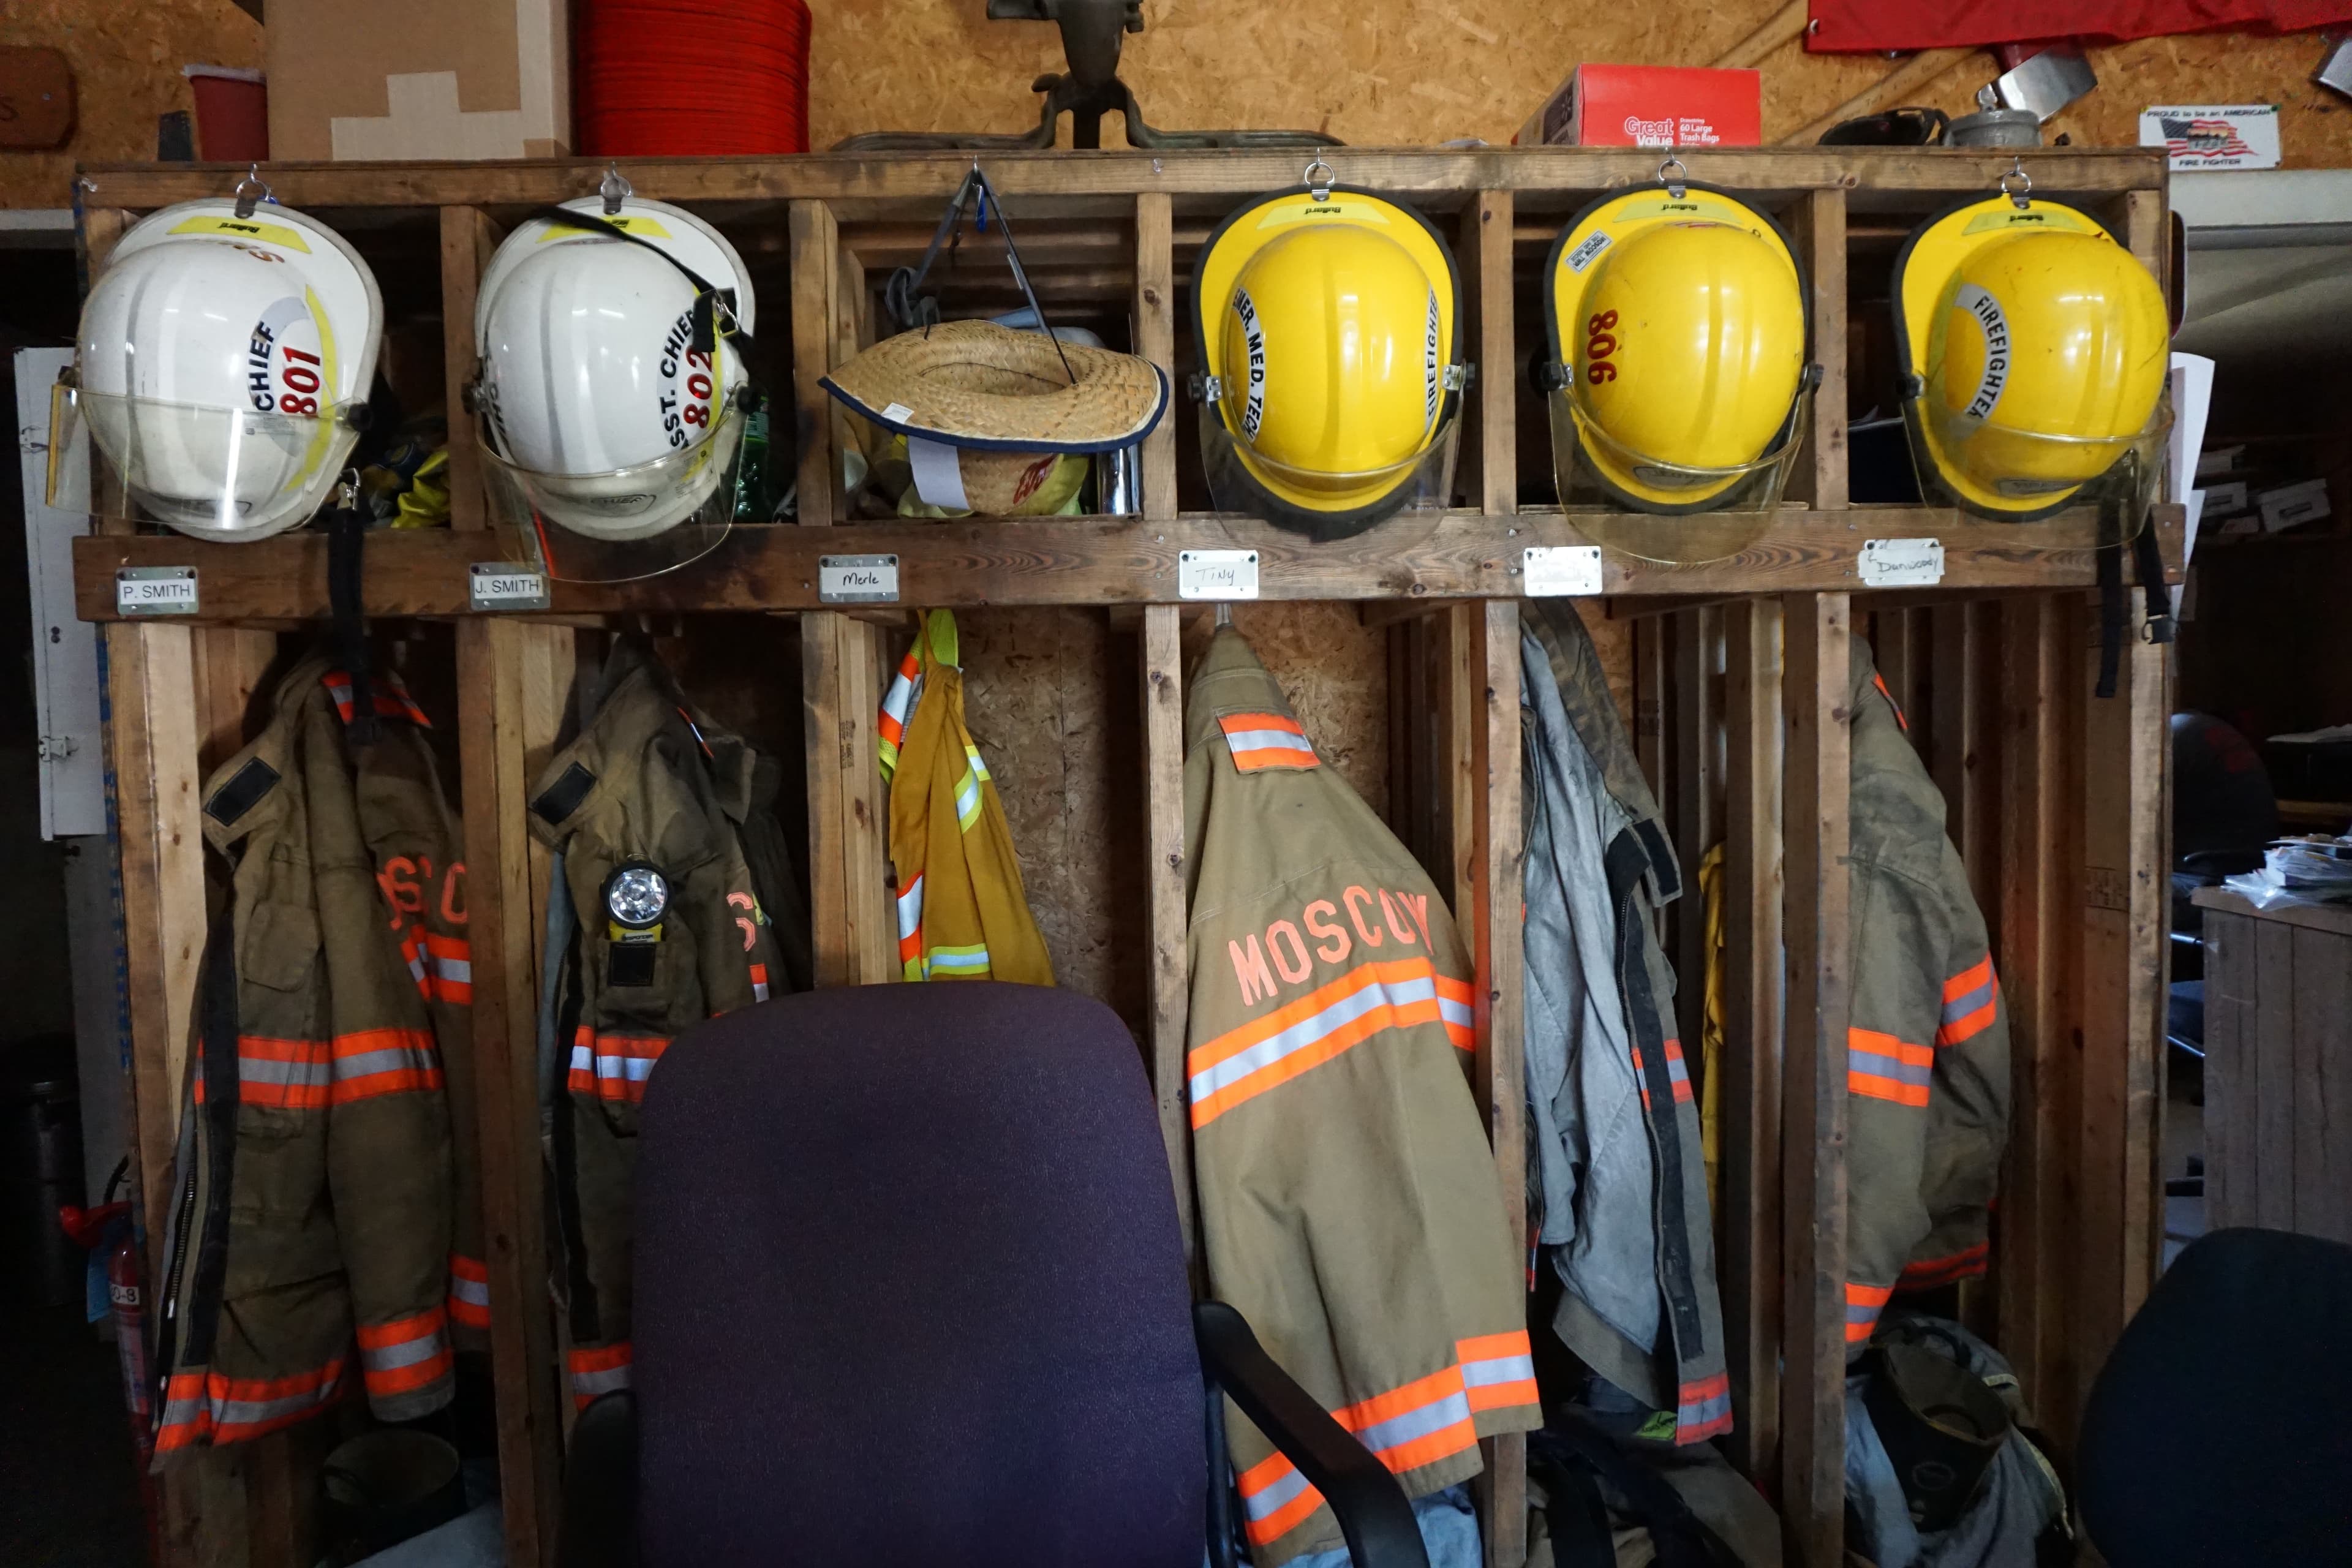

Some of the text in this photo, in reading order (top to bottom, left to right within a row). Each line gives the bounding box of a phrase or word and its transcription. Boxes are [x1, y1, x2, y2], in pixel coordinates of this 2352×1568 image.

[1624, 116, 1674, 136] Great
[1636, 134, 1674, 146] Value
[1680, 124, 1713, 134] 60 Large
[1680, 133, 1720, 143] Trash Bags
[248, 320, 275, 412] CHIEF
[1248, 331, 1264, 387] MED.
[1428, 289, 1438, 418] FIREFIGHTE
[1587, 309, 1618, 385] 806
[279, 346, 320, 418] 801
[683, 344, 713, 429] 802
[1242, 394, 1262, 440] TECH
[123, 584, 190, 598] P. SMITH
[475, 579, 539, 594] J. SMITH
[843, 571, 880, 586] Merle
[1228, 885, 1434, 1006] MOSCOW
